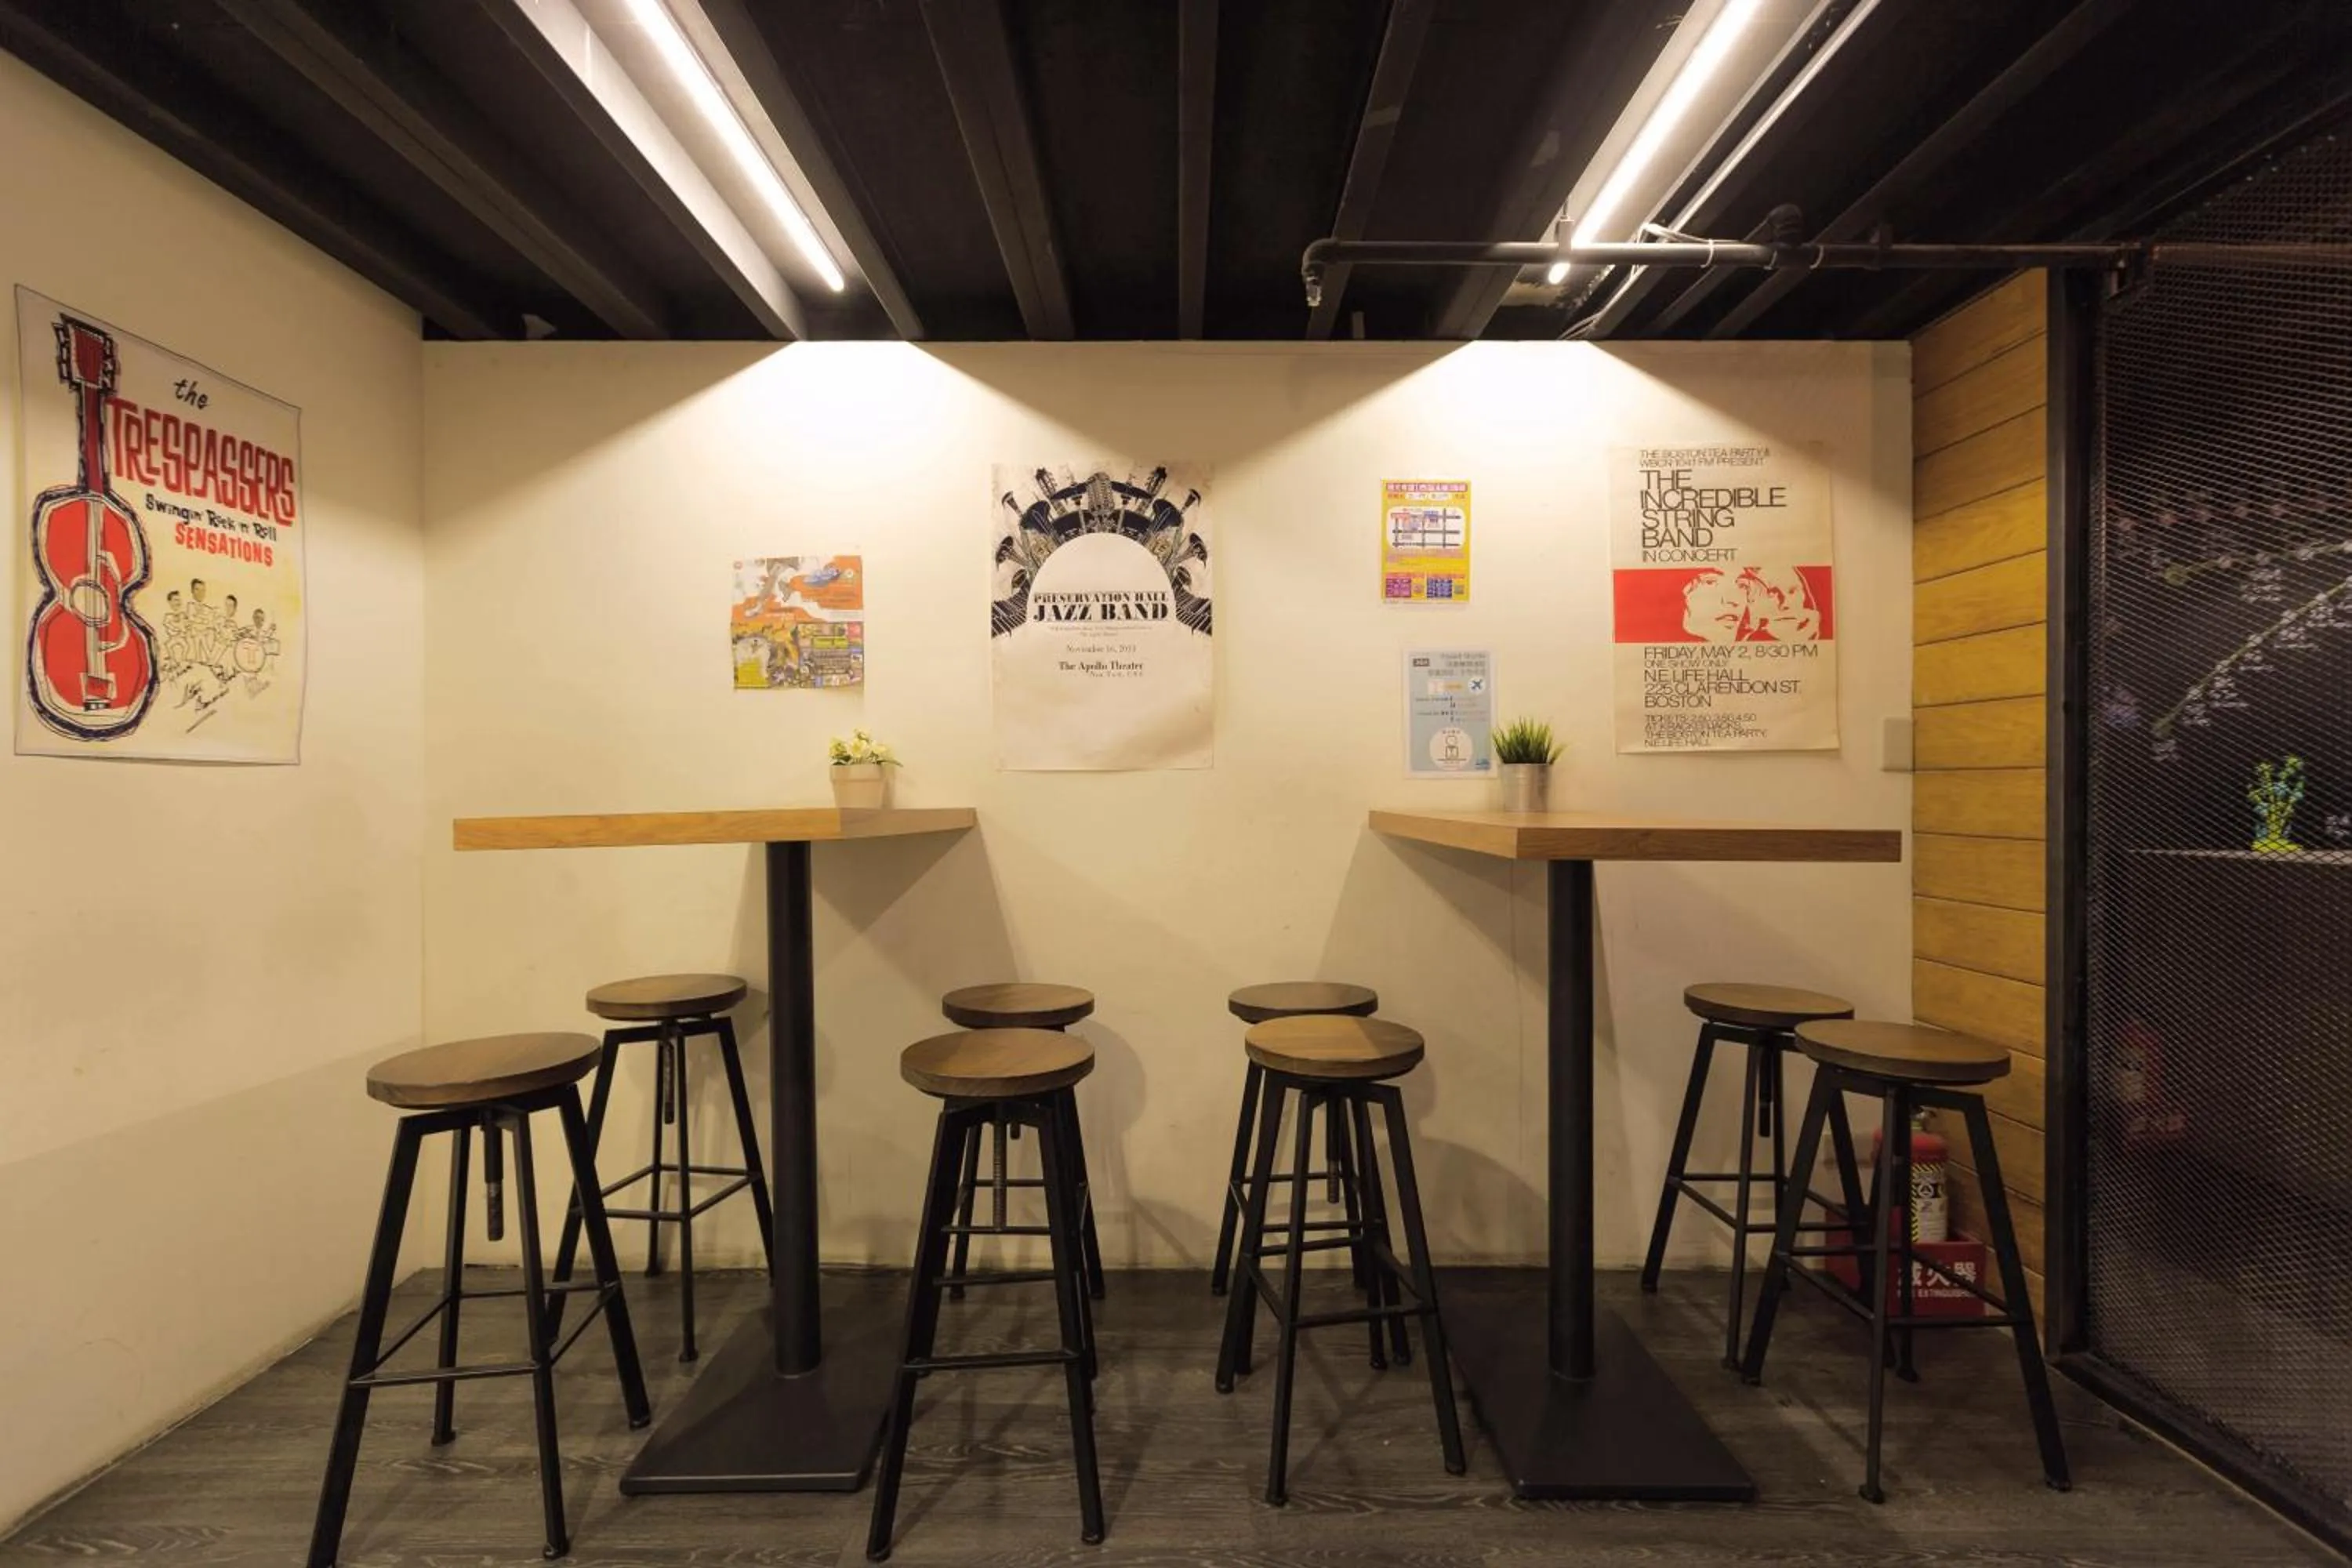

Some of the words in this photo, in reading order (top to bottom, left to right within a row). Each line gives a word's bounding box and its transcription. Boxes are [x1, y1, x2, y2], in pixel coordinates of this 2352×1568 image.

[174, 379, 209, 410] the
[104, 397, 296, 527] TRESPASSERS
[1640, 449, 1659, 458] THE
[1639, 469, 1692, 490] THE
[1639, 487, 1787, 510] INCREDIBLE
[205, 509, 235, 532] Rock
[252, 521, 277, 541] Roll
[1642, 508, 1735, 528] STRING
[175, 521, 274, 568] SENSATIONS
[1642, 527, 1714, 548] BAND
[1642, 550, 1657, 563] IN
[1658, 548, 1739, 563] CONCERT
[1033, 591, 1130, 604] PRESERVATION
[1134, 591, 1169, 602] HALL
[1033, 604, 1092, 622] JAZZ
[1101, 603, 1169, 621] BAND
[1067, 644, 1104, 653] November
[1701, 645, 1735, 659] MAY
[1792, 644, 1818, 657] PM
[1058, 661, 1076, 670] The
[1079, 661, 1108, 673] Apollo
[1673, 669, 1705, 682] LIFE
[1707, 668, 1751, 681] HALL
[1645, 683, 1673, 695] 225
[1675, 680, 1777, 695] CLARENDON
[1644, 695, 1712, 707] BOSTON
